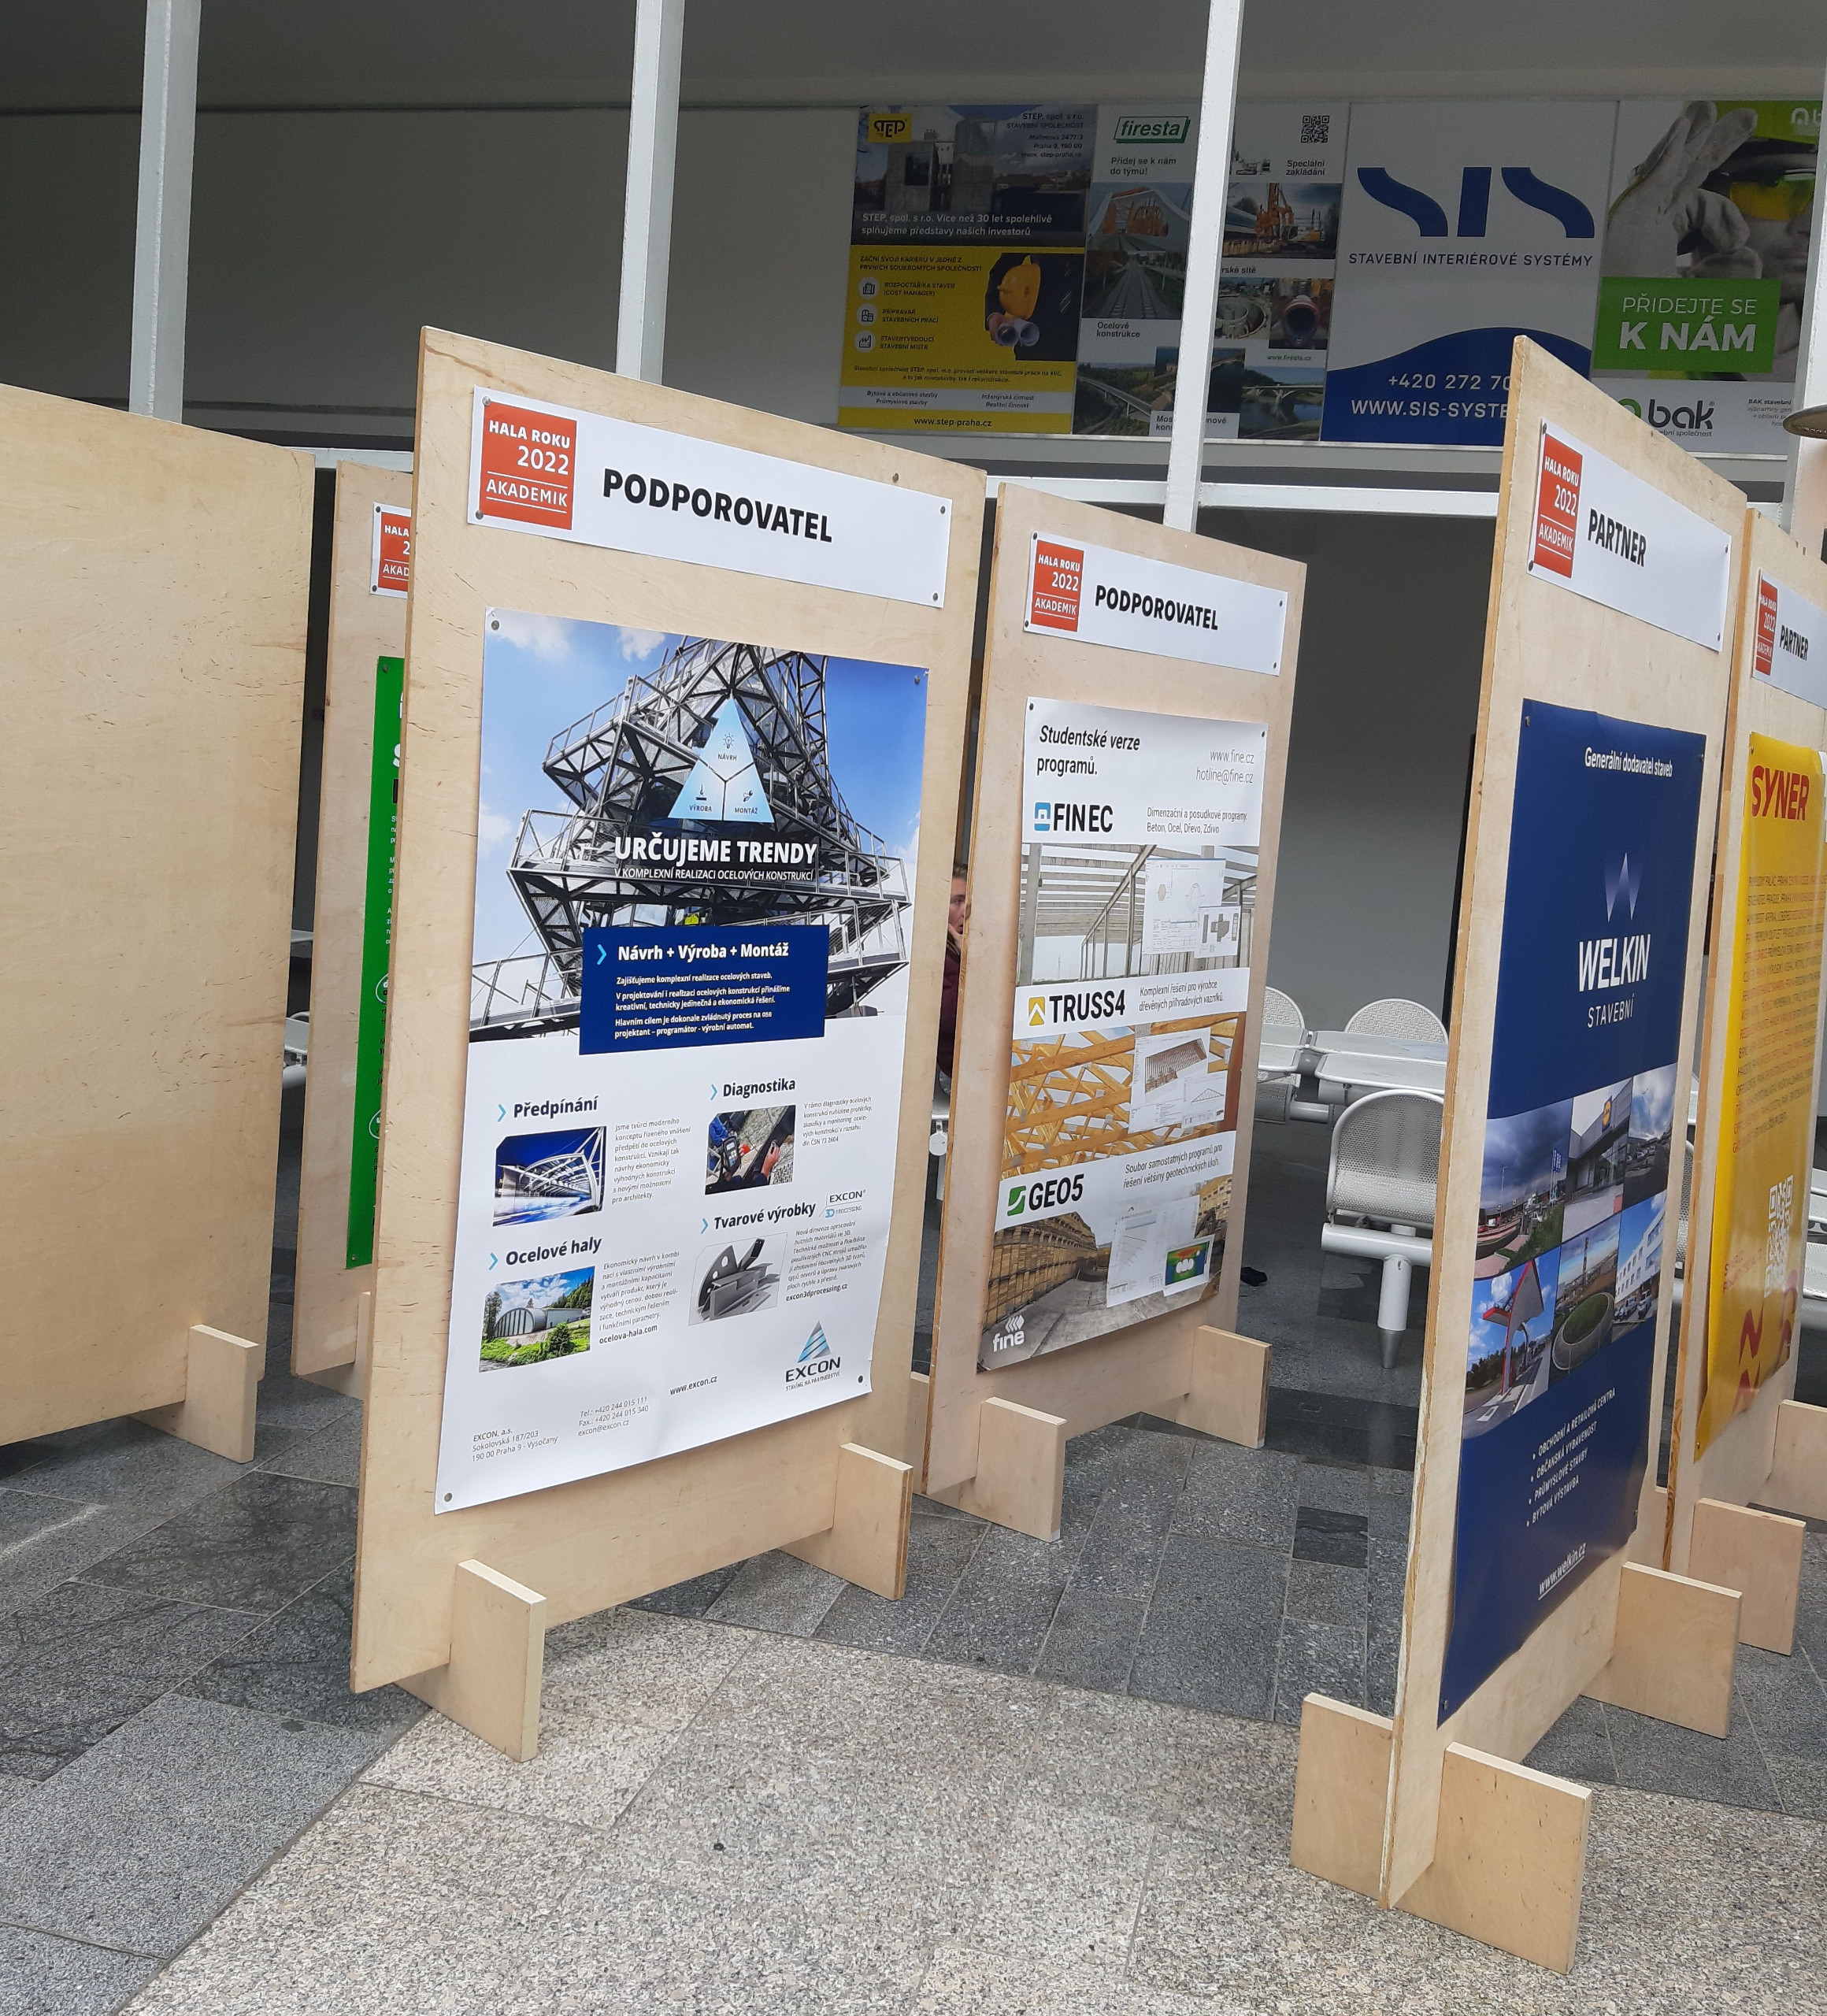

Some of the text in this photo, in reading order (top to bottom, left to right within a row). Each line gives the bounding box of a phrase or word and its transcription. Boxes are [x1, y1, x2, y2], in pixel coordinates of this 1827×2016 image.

[874, 120, 906, 137] STEP
[1121, 120, 1180, 136] firesta
[1123, 168, 1147, 176] týmu!
[1287, 160, 1325, 169] Speciální
[1357, 166, 1595, 238] SIS
[959, 214, 975, 223] než
[976, 214, 989, 223] 30
[992, 214, 1003, 223] let
[1006, 214, 1052, 224] spolehlivě
[910, 227, 954, 236] představy
[988, 228, 1031, 236] investorů
[1349, 251, 1592, 266] STAVEBNÍ INTERIÉROVÉ SYSTÉMY
[1622, 294, 1757, 315] PŘIDEJTE SE
[1620, 316, 1756, 352] K NÁM
[1388, 373, 1510, 391] +420 272 70
[1351, 399, 1508, 418] WWW.SIS-SYSTE
[1648, 399, 1714, 429] bak
[914, 418, 992, 428] www.step-praha.cz
[489, 420, 570, 449] HALA ROKU
[517, 445, 569, 475] 2022
[1545, 455, 1580, 487] HALA ROKU
[486, 479, 568, 507] AKADEMIK
[1555, 484, 1577, 517] 2022
[603, 467, 833, 544] PODPOROVATEL
[384, 524, 410, 537] HALA
[1539, 523, 1573, 553] AKADEMIK
[1588, 507, 1647, 567] PARTNER
[383, 564, 410, 576] AKAD
[1038, 554, 1080, 573] HALA ROKU
[1051, 572, 1079, 591] 2022
[1035, 597, 1077, 616] AKADEMIK
[1095, 584, 1218, 631] PODPOROVATEL
[1780, 624, 1809, 661] PARTNER
[1039, 724, 1140, 750] Studentské verze
[717, 753, 738, 762] NÁVRH
[1037, 756, 1098, 776] programů.
[1210, 750, 1254, 764] www.fine.cz
[1584, 747, 1673, 778] Generální dodavatel staveb
[1196, 768, 1254, 784] hotline@fine.cz
[1751, 765, 1810, 821] SYNER
[1053, 802, 1114, 833] FINEC
[1147, 807, 1183, 818] Dimenzační
[1189, 810, 1221, 821] posudkové
[1147, 822, 1219, 834] Beton, Ocel, Dřevo, Zdivo
[614, 832, 818, 867] URČUJEME TRENDY
[614, 866, 813, 880] V KOMPLEXNÍ REALIZACI OCELOVÝCH KONSTRUKCÍ
[617, 942, 789, 962] Návrh + Výroba + Montáž
[1578, 933, 1651, 992] WELKIN
[1140, 980, 1217, 997] Komplexní pro výrobce
[1049, 989, 1125, 1024] TRUSS4
[1587, 992, 1636, 1028] STAVEBNÍ
[723, 1078, 795, 1099] Diagnostika
[513, 1095, 599, 1119] Předpínání
[1125, 1144, 1222, 1174] Soubor samostatných programů pro
[1123, 1162, 1206, 1188] řešení většiny geotechnických
[1028, 1174, 1084, 1211] GEO5
[714, 1202, 817, 1229] Tvarové výrobky
[506, 1236, 602, 1266] Ocelové haly
[786, 1283, 847, 1302] excon3dprocessing.cz
[599, 1324, 658, 1344] ocelova-hala.com
[992, 1330, 1025, 1352] fine
[786, 1357, 841, 1383] EXCON
[670, 1376, 717, 1395] www.excon.cz
[595, 1414, 610, 1423] +420
[611, 1411, 623, 1420] 244
[637, 1405, 649, 1414] 340
[1539, 1388, 1616, 1457] OBCHODNÍ A RETAILOVÁ CENTRA
[473, 1430, 499, 1442] EXCON,
[578, 1420, 629, 1436] excon@excon.cz
[472, 1430, 539, 1452] Sokolovská 187/203
[495, 1446, 516, 1456] Praha
[527, 1436, 558, 1449] Vysočany
[1536, 1421, 1597, 1479] OBČANSKÁ VYBAVENOST
[1534, 1447, 1588, 1501] PRŮMYSLOVÉ STAVBY
[1532, 1475, 1579, 1524] BYTOVÁ VÝSTAVBA
[1539, 1543, 1586, 1595] www.welkin.cz
